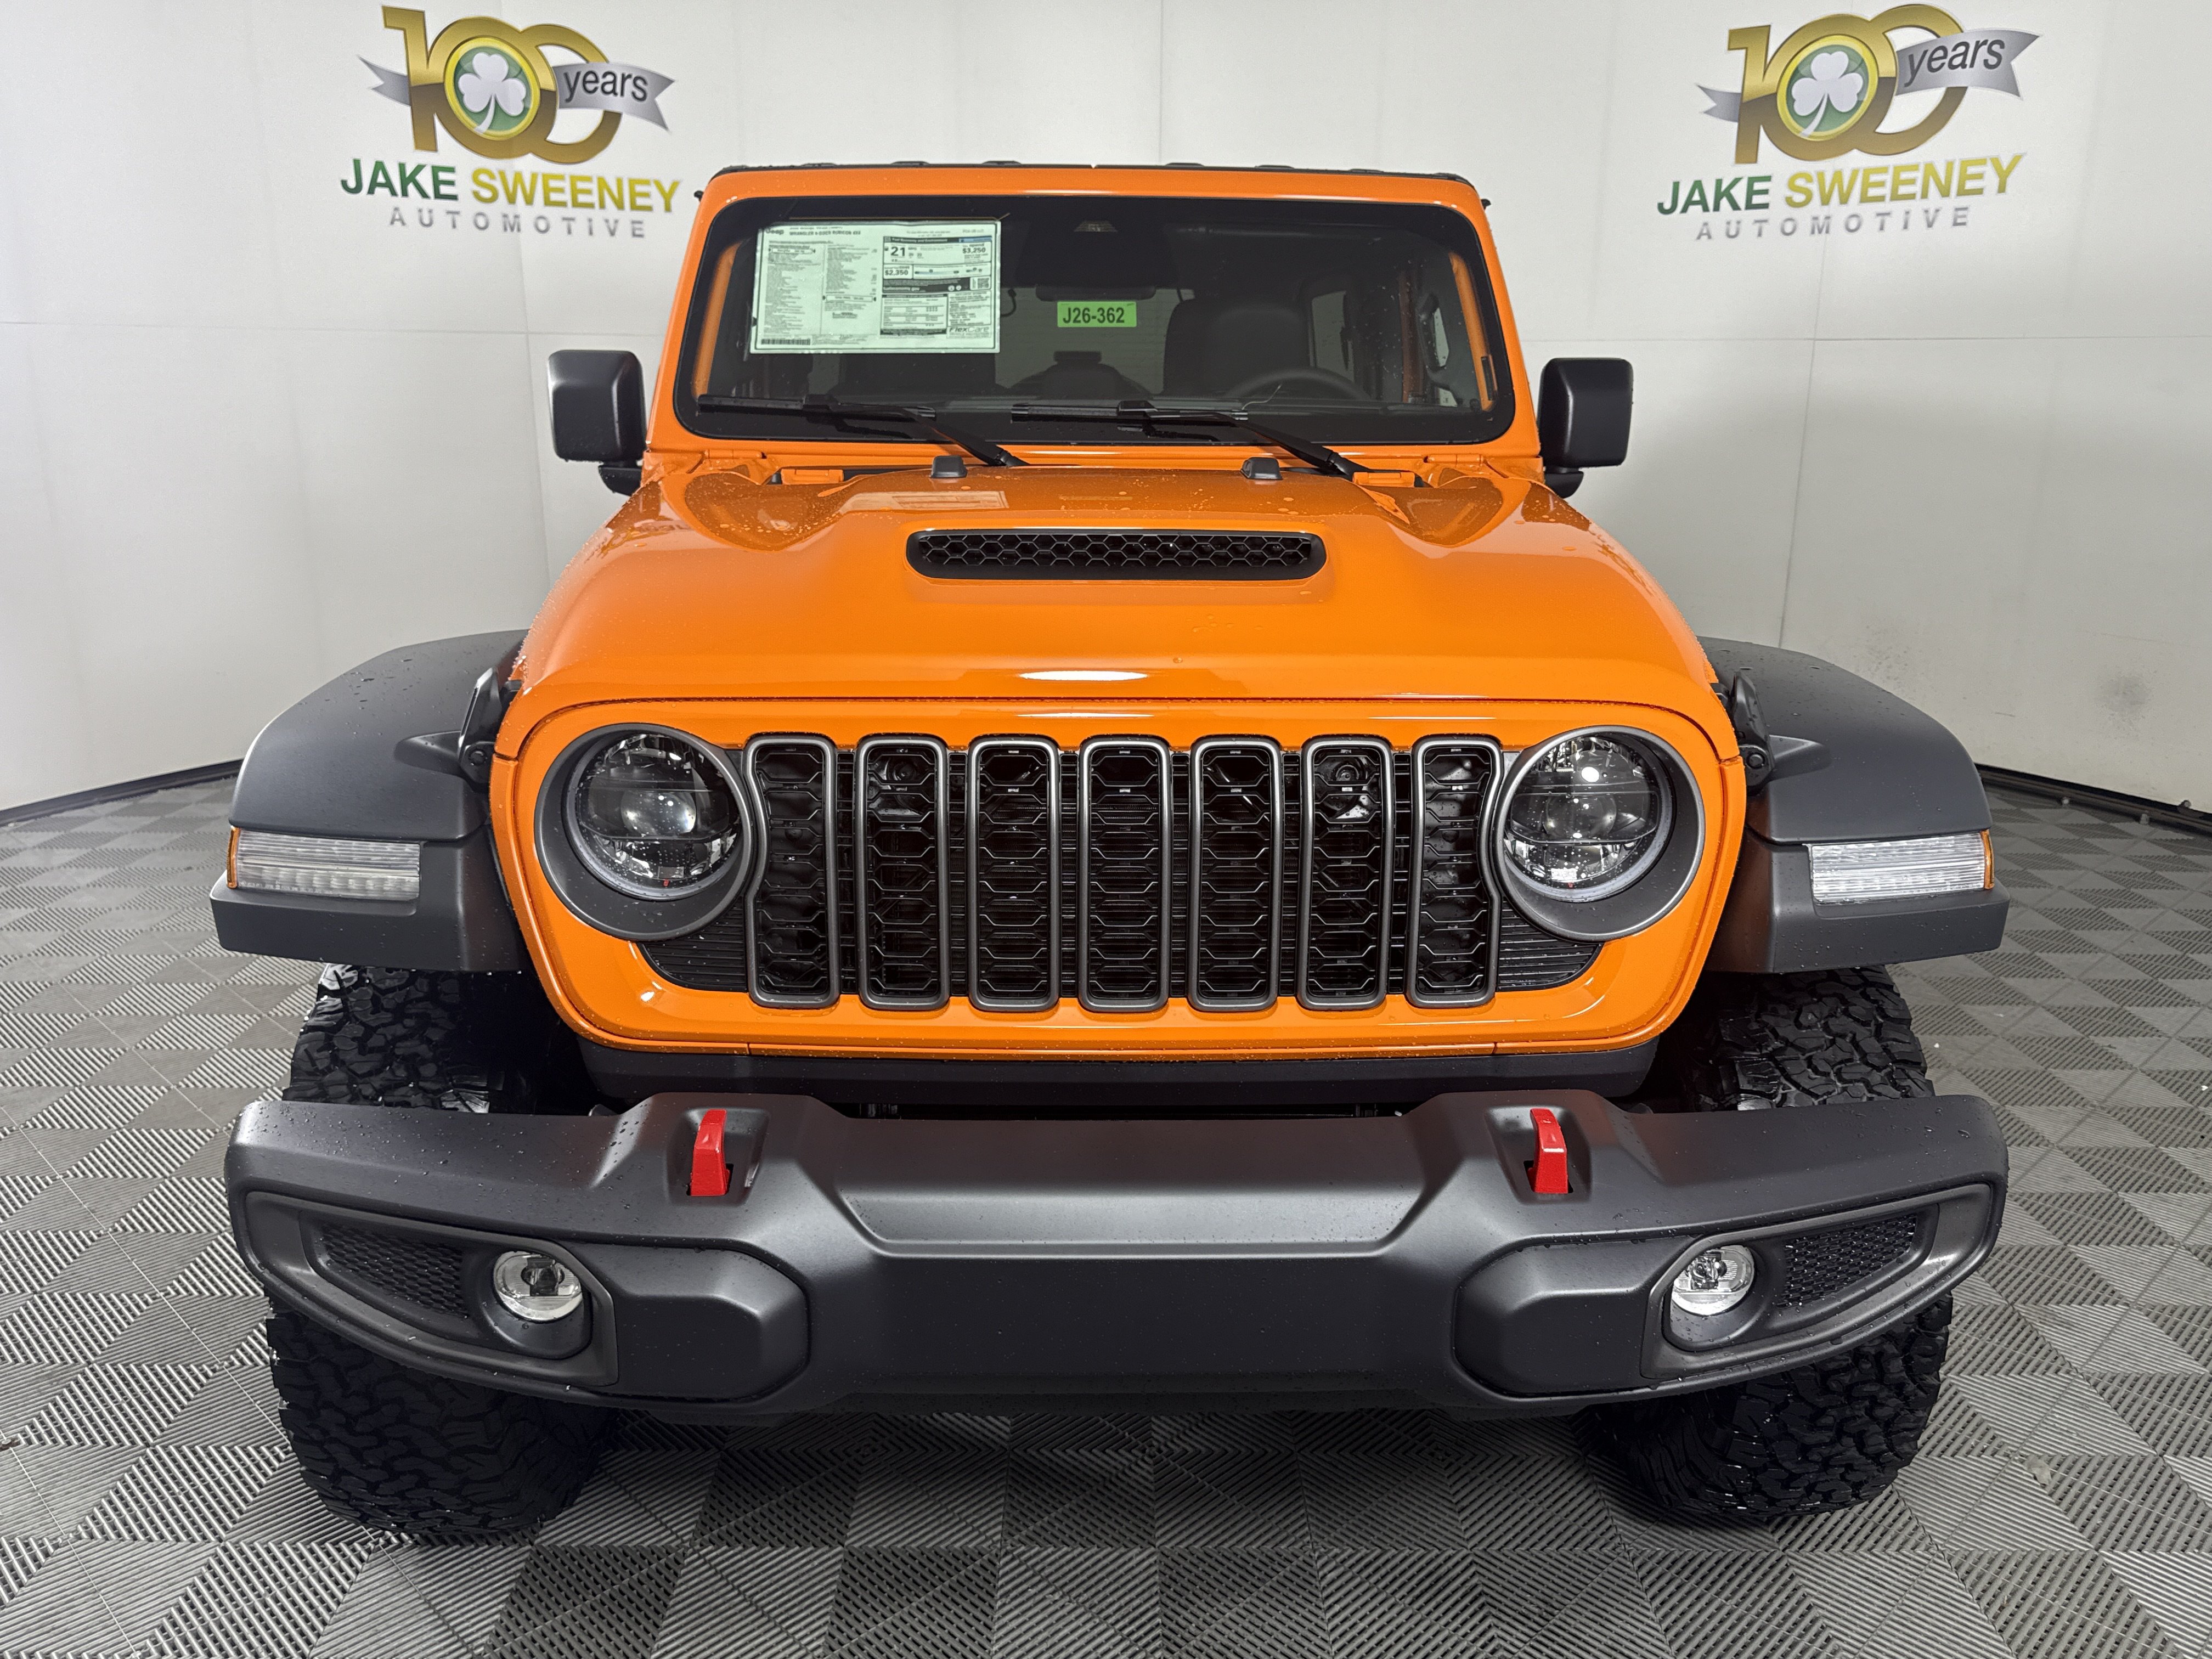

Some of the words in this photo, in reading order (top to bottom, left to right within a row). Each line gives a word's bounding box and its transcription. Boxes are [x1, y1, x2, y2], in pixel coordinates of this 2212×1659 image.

[382, 5, 623, 165] 100
[563, 70, 648, 103] years
[1727, 4, 1970, 164] 100
[1904, 37, 2006, 87] years
[341, 159, 459, 201] JAKE
[471, 168, 680, 213] SWEENEY
[1657, 175, 1773, 215] JAKE
[1785, 154, 2024, 208] SWEENEY
[389, 207, 645, 238] AUTOMOTIVE
[1696, 206, 1970, 240] AUTOMOTIVE
[890, 246, 906, 256] 21
[1063, 307, 1125, 323] J26-362
